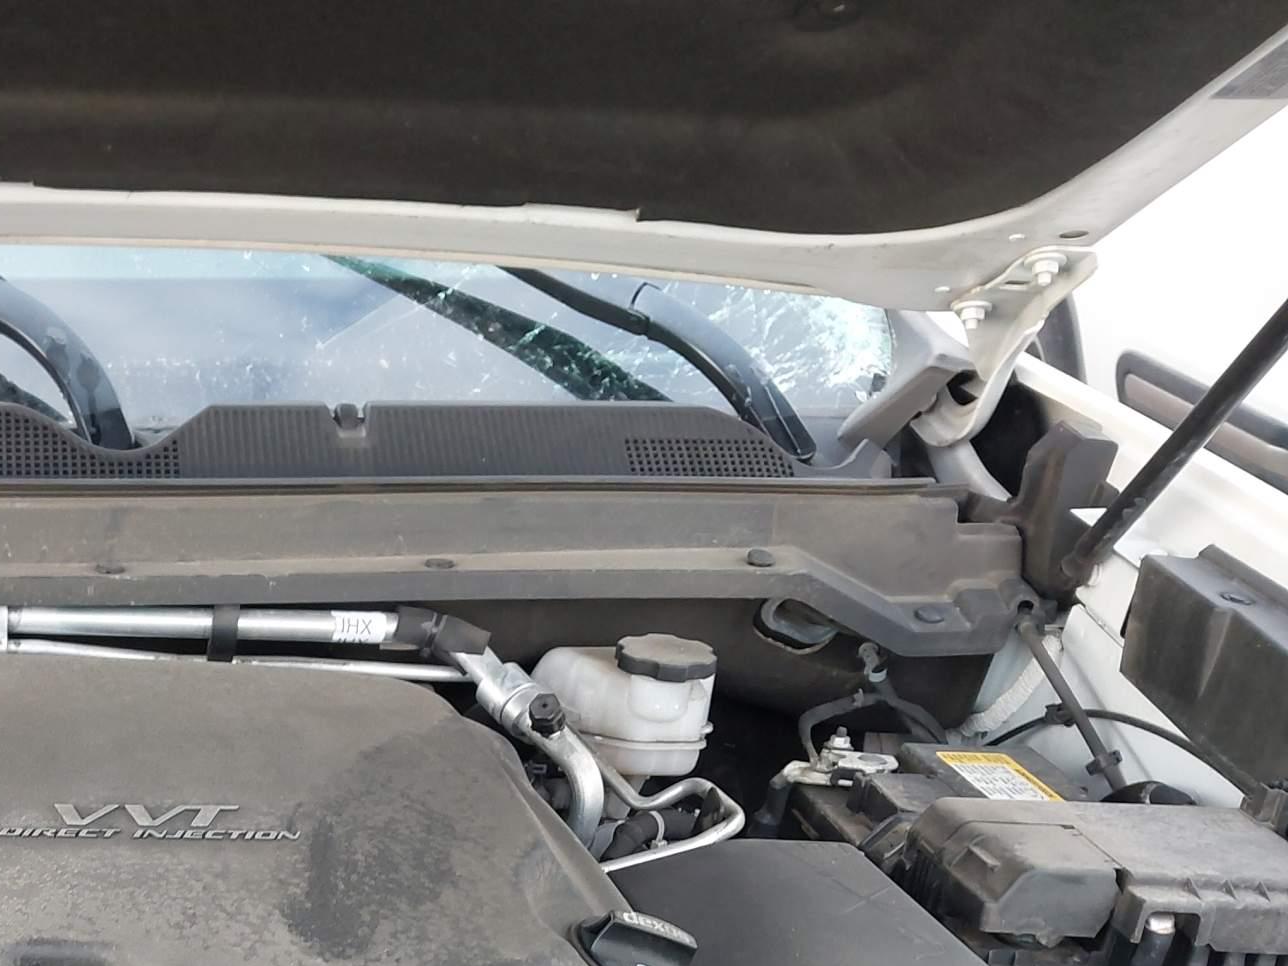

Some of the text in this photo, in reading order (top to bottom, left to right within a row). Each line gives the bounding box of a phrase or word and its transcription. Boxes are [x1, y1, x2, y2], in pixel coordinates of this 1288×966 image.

[54, 803, 240, 827] VVT
[0, 826, 302, 841] DIRECT INJECTION
